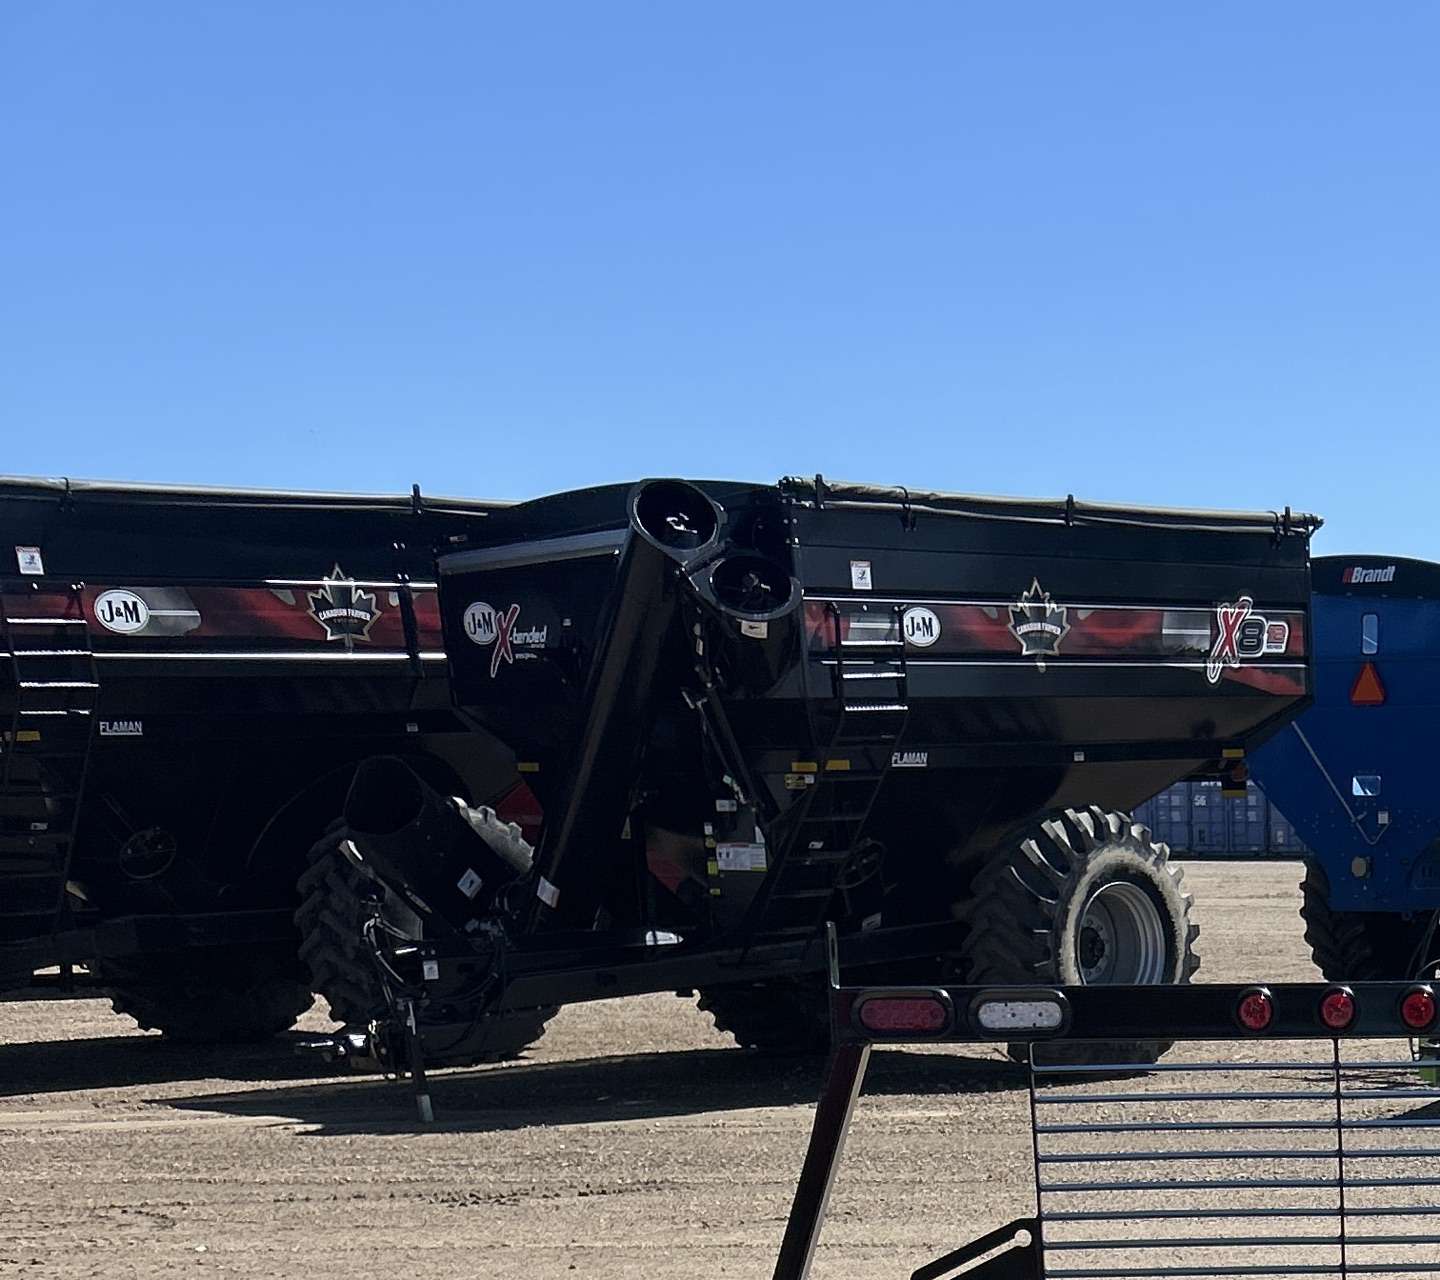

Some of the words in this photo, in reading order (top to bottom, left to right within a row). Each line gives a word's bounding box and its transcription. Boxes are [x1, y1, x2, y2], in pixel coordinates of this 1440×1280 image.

[1351, 565, 1396, 583] Brandt
[100, 600, 141, 623] J&M
[905, 616, 934, 638] J&M
[100, 721, 143, 734] FLAMAN
[891, 752, 928, 764] FLAMAN
